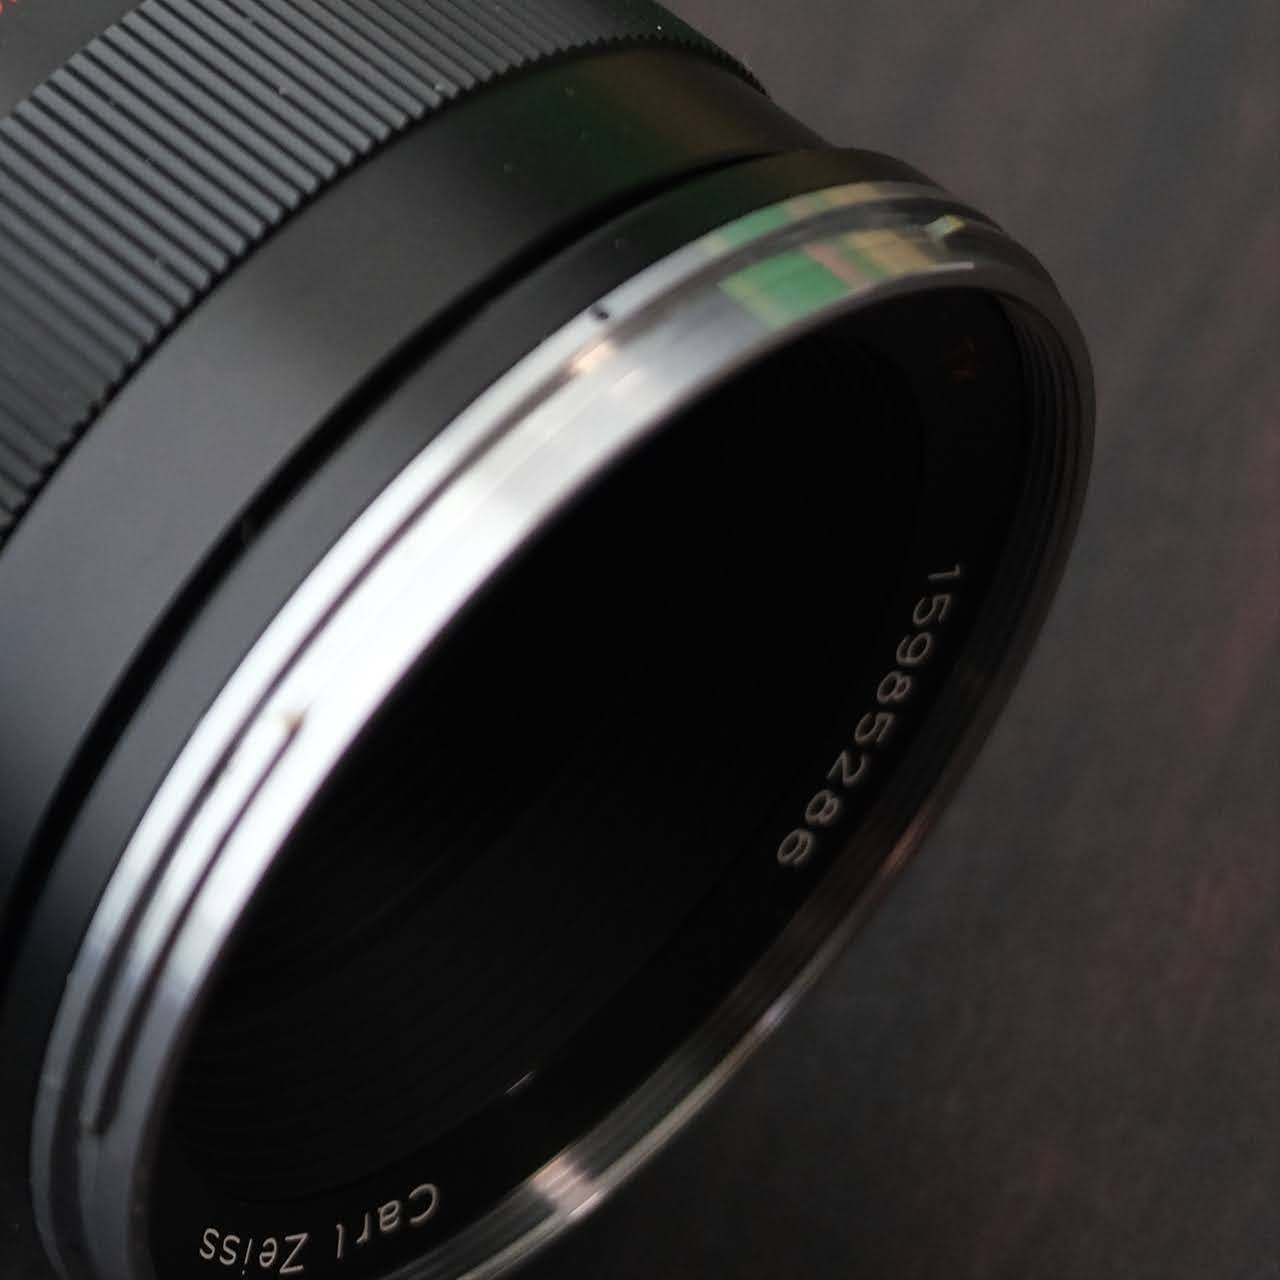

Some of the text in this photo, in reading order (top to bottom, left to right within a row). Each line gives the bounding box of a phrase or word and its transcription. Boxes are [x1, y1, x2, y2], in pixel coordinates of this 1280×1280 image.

[776, 564, 961, 865] 15985286
[199, 1182, 439, 1274] Carl Zeiss
